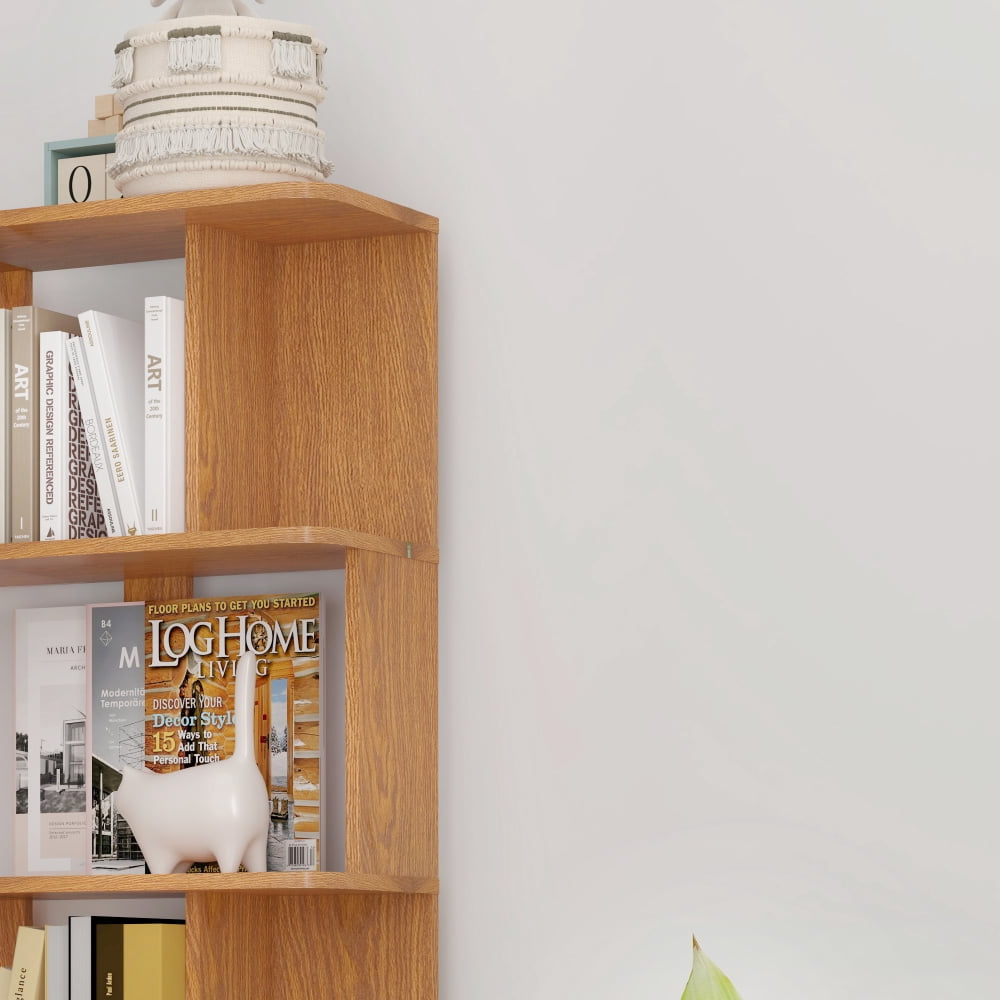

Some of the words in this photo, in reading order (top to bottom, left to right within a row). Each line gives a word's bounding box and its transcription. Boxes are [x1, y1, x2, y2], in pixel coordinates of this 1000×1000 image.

[14, 363, 29, 400] ART
[45, 350, 54, 395] GRAPHIC
[148, 354, 162, 391] ART
[45, 399, 54, 435] DESIGN
[86, 418, 104, 472] BORDEAUX
[104, 417, 121, 460] SAARINEN
[45, 439, 54, 505] REFERENCED
[115, 462, 125, 483] EERO
[148, 603, 178, 615] FLOOR
[181, 602, 212, 613] PLANS
[215, 601, 227, 611] TO
[229, 600, 247, 611] GET
[251, 599, 270, 609] YOU
[273, 597, 316, 609] STARTED
[47, 646, 75, 655] MARIA
[198, 659, 269, 678] LIVIG
[153, 697, 196, 710] DISCOVER
[199, 697, 223, 708] YOUR
[152, 713, 197, 728] Decor
[152, 731, 176, 752] 15
[177, 730, 201, 741] Ways
[203, 730, 213, 738] to
[178, 742, 195, 752] Add
[198, 741, 218, 751] That
[153, 754, 191, 765] Personal
[194, 753, 220, 764] Touch
